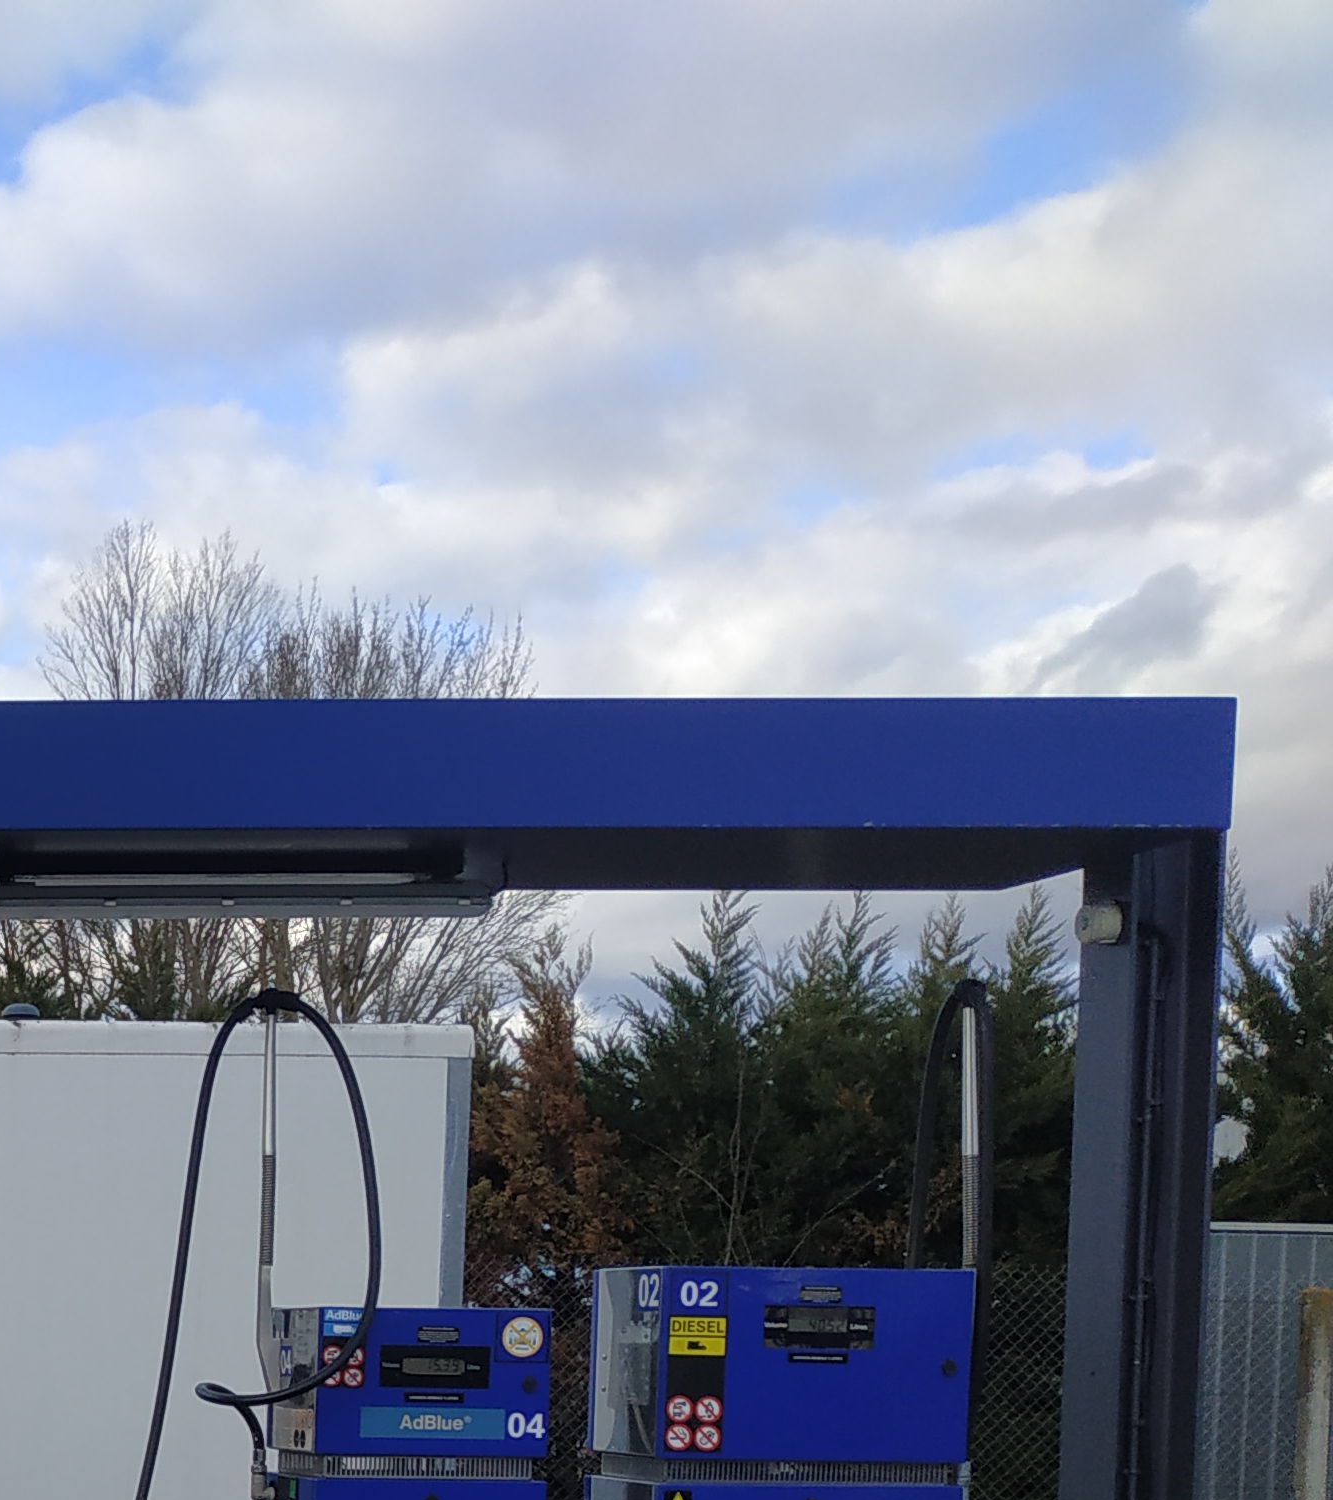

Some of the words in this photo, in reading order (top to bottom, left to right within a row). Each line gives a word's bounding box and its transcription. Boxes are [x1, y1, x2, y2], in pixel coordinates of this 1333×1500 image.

[638, 1273, 660, 1308] 02
[680, 1280, 719, 1307] 02
[324, 1309, 362, 1321] AdBlu
[671, 1319, 725, 1334] DIESEL
[507, 1412, 546, 1439] 04
